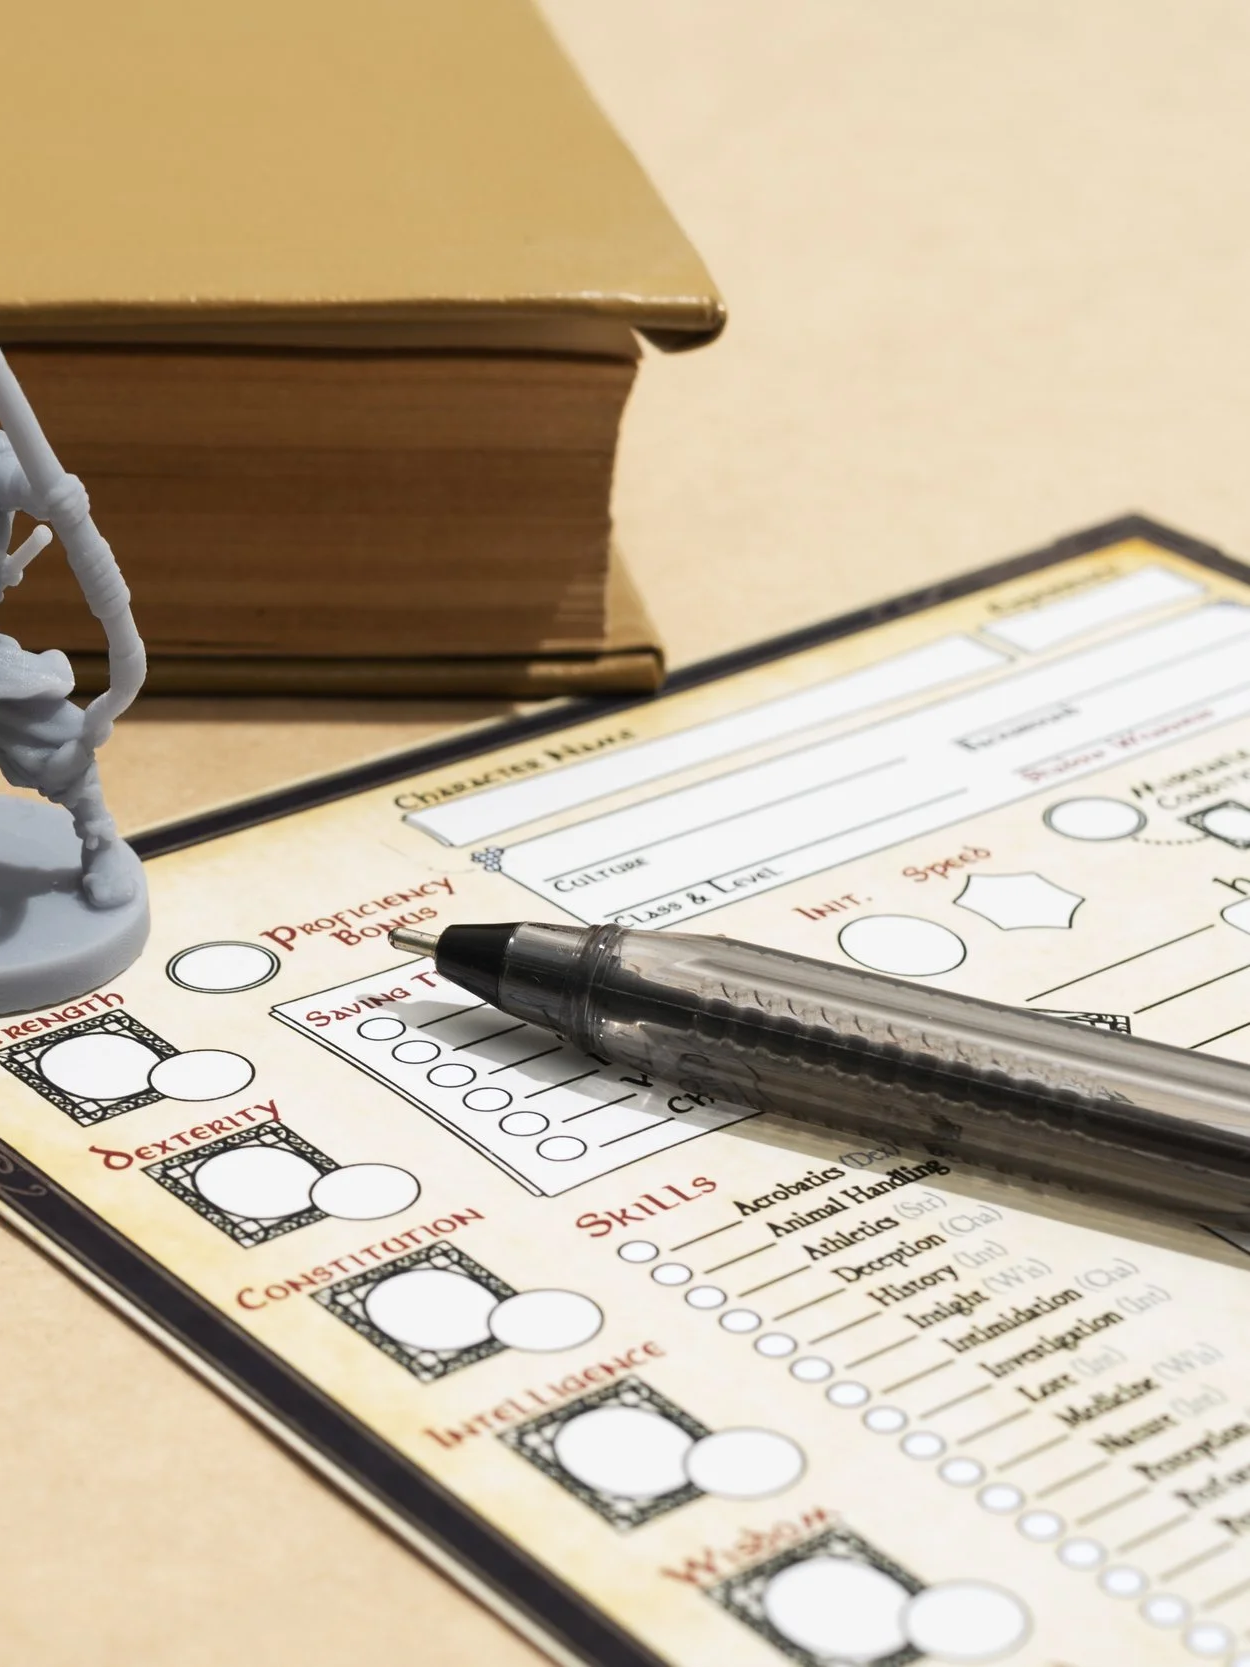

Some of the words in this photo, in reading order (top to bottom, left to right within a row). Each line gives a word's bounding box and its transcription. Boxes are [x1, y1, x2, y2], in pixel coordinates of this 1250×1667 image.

[732, 1166, 845, 1217] Acrobatics
[838, 1140, 903, 1169] (Dex)
[765, 1196, 850, 1239] Animal
[840, 1159, 951, 1204] Handling
[801, 1215, 900, 1262] Athletics
[892, 1190, 948, 1221] (Str)
[830, 1233, 947, 1284] Deception
[939, 1203, 1004, 1238] (Cha)
[865, 1264, 961, 1308] History
[903, 1289, 992, 1330] Insight
[939, 1287, 1086, 1354] Intimidation
